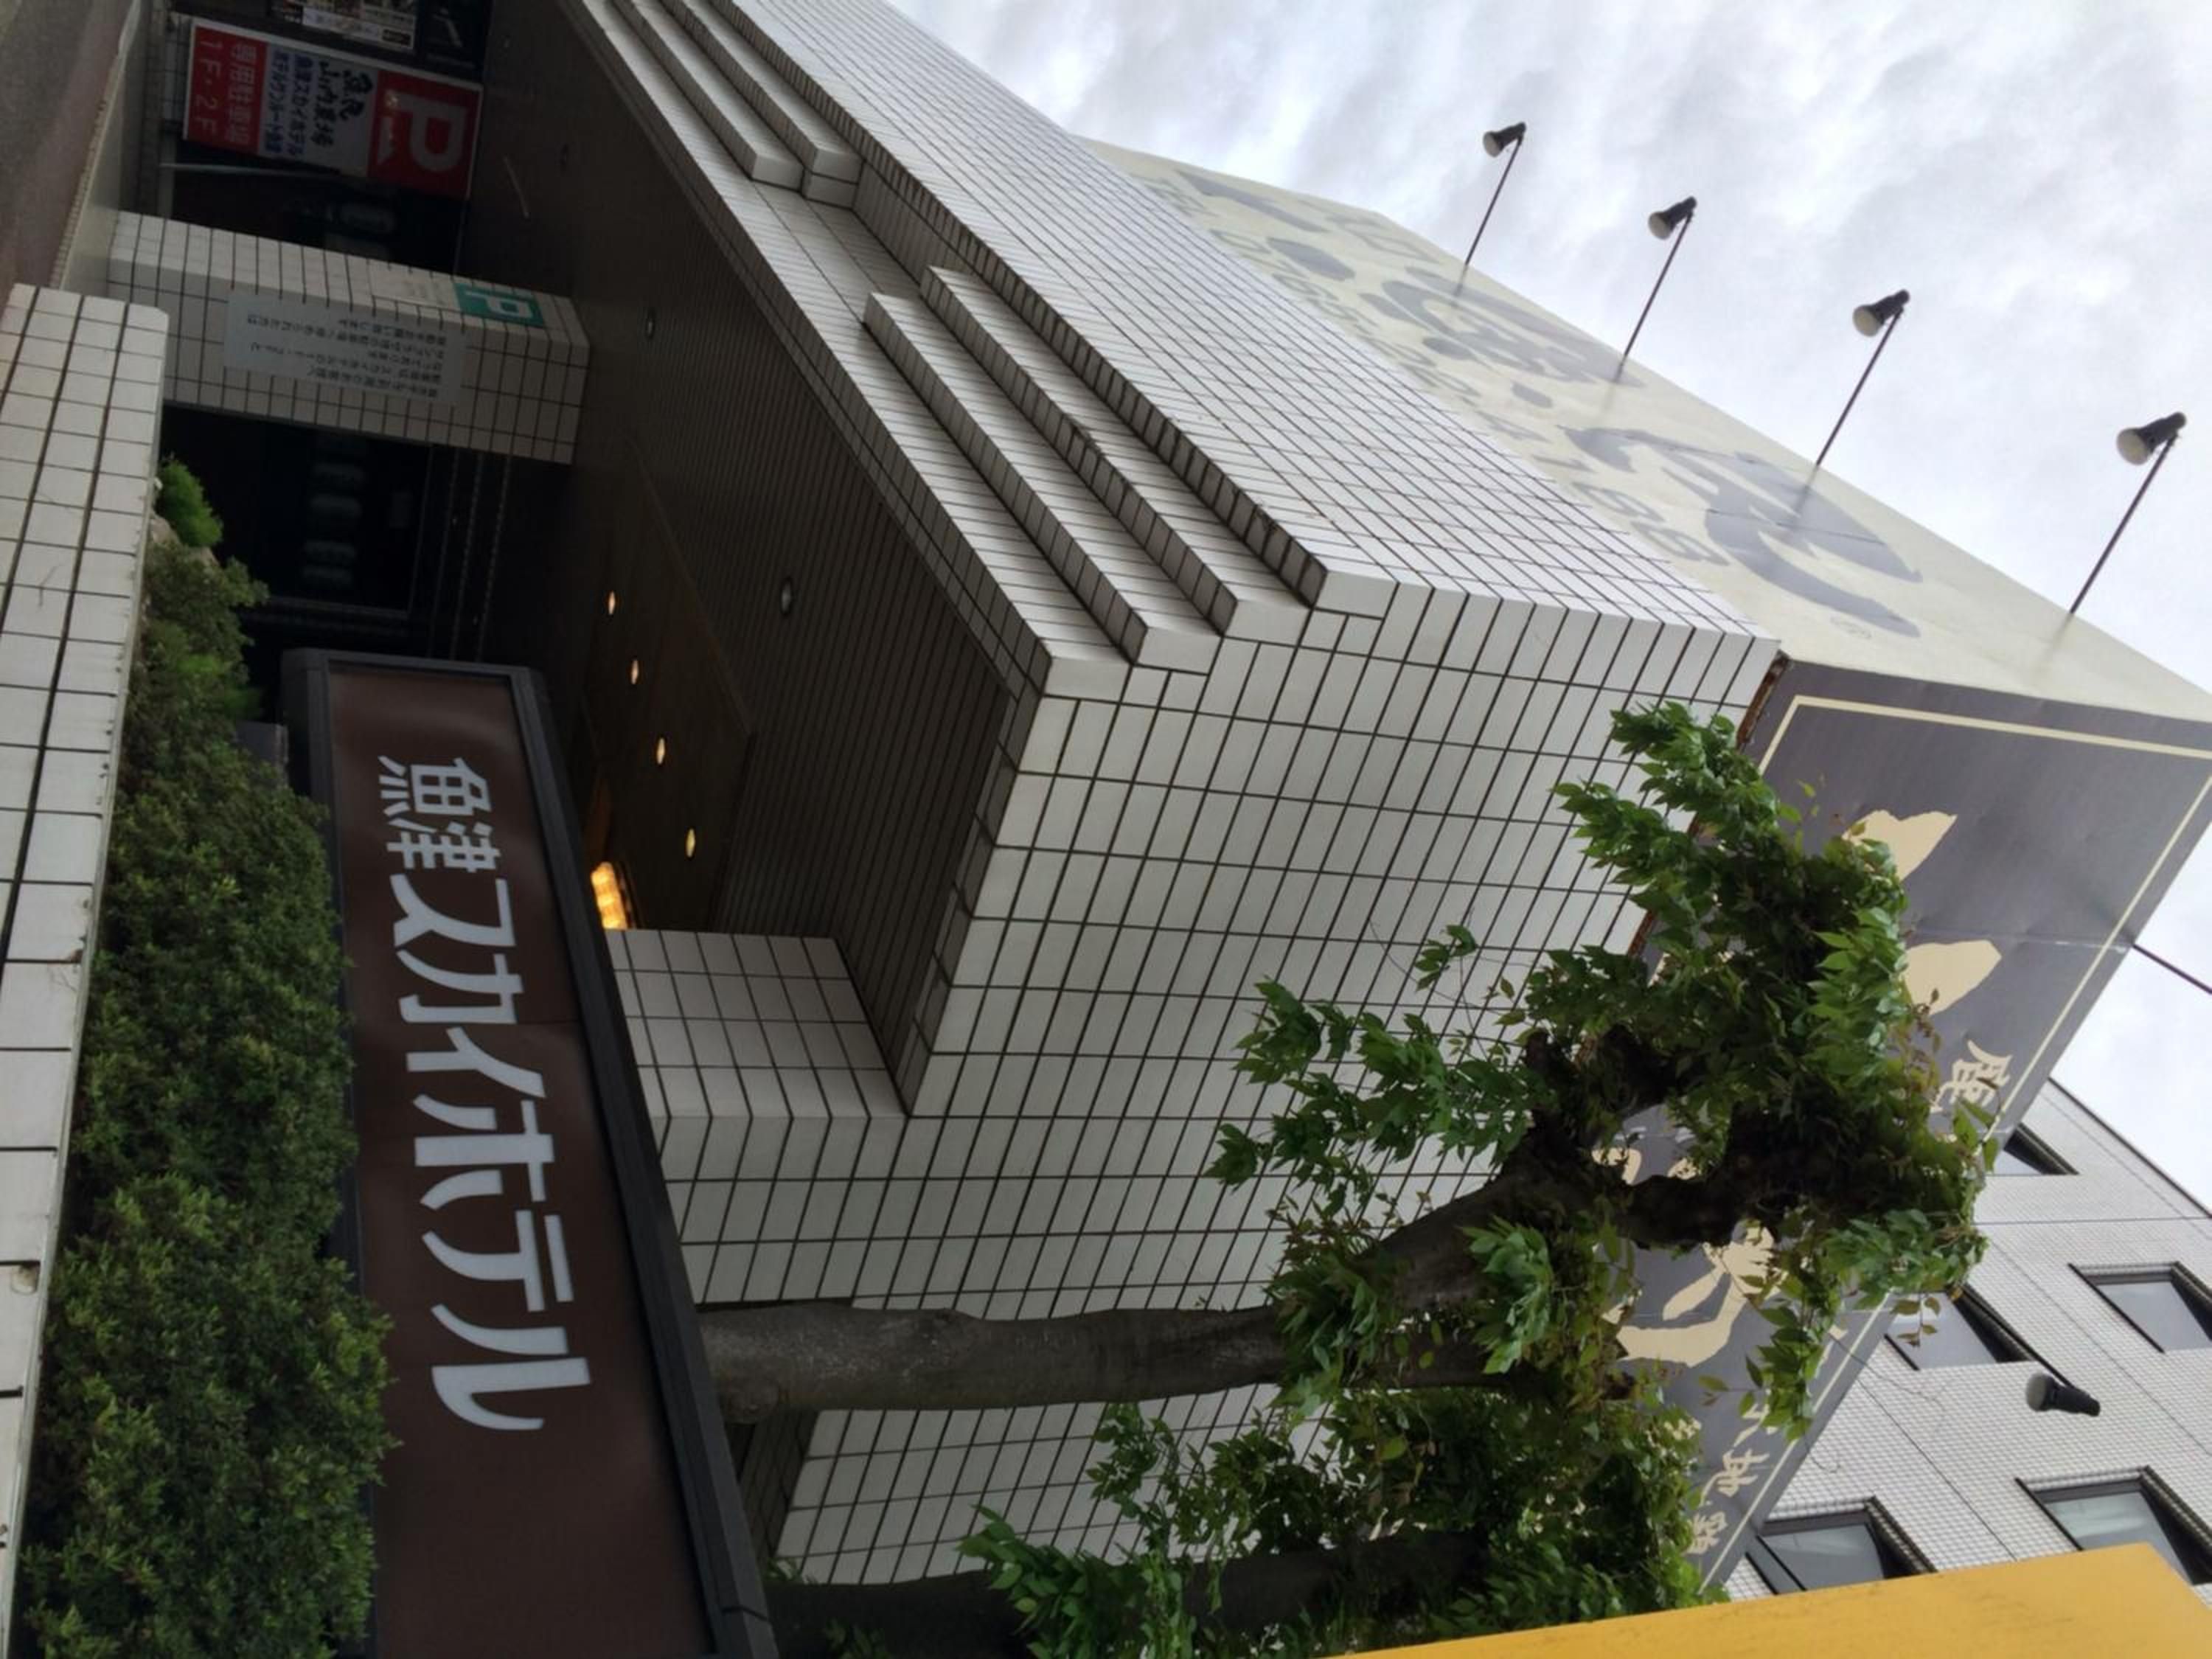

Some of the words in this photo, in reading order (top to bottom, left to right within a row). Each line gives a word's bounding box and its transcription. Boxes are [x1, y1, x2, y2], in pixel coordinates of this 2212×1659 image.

[224, 43, 257, 145] 専用駐車場
[288, 54, 314, 156] 魚津スカイホテル
[385, 90, 469, 173] P
[463, 288, 535, 320] P
[1210, 228, 1731, 566] 0765-22-4188
[1357, 265, 1923, 637] 魚民
[378, 755, 591, 1431] 魚津スカイホテル
